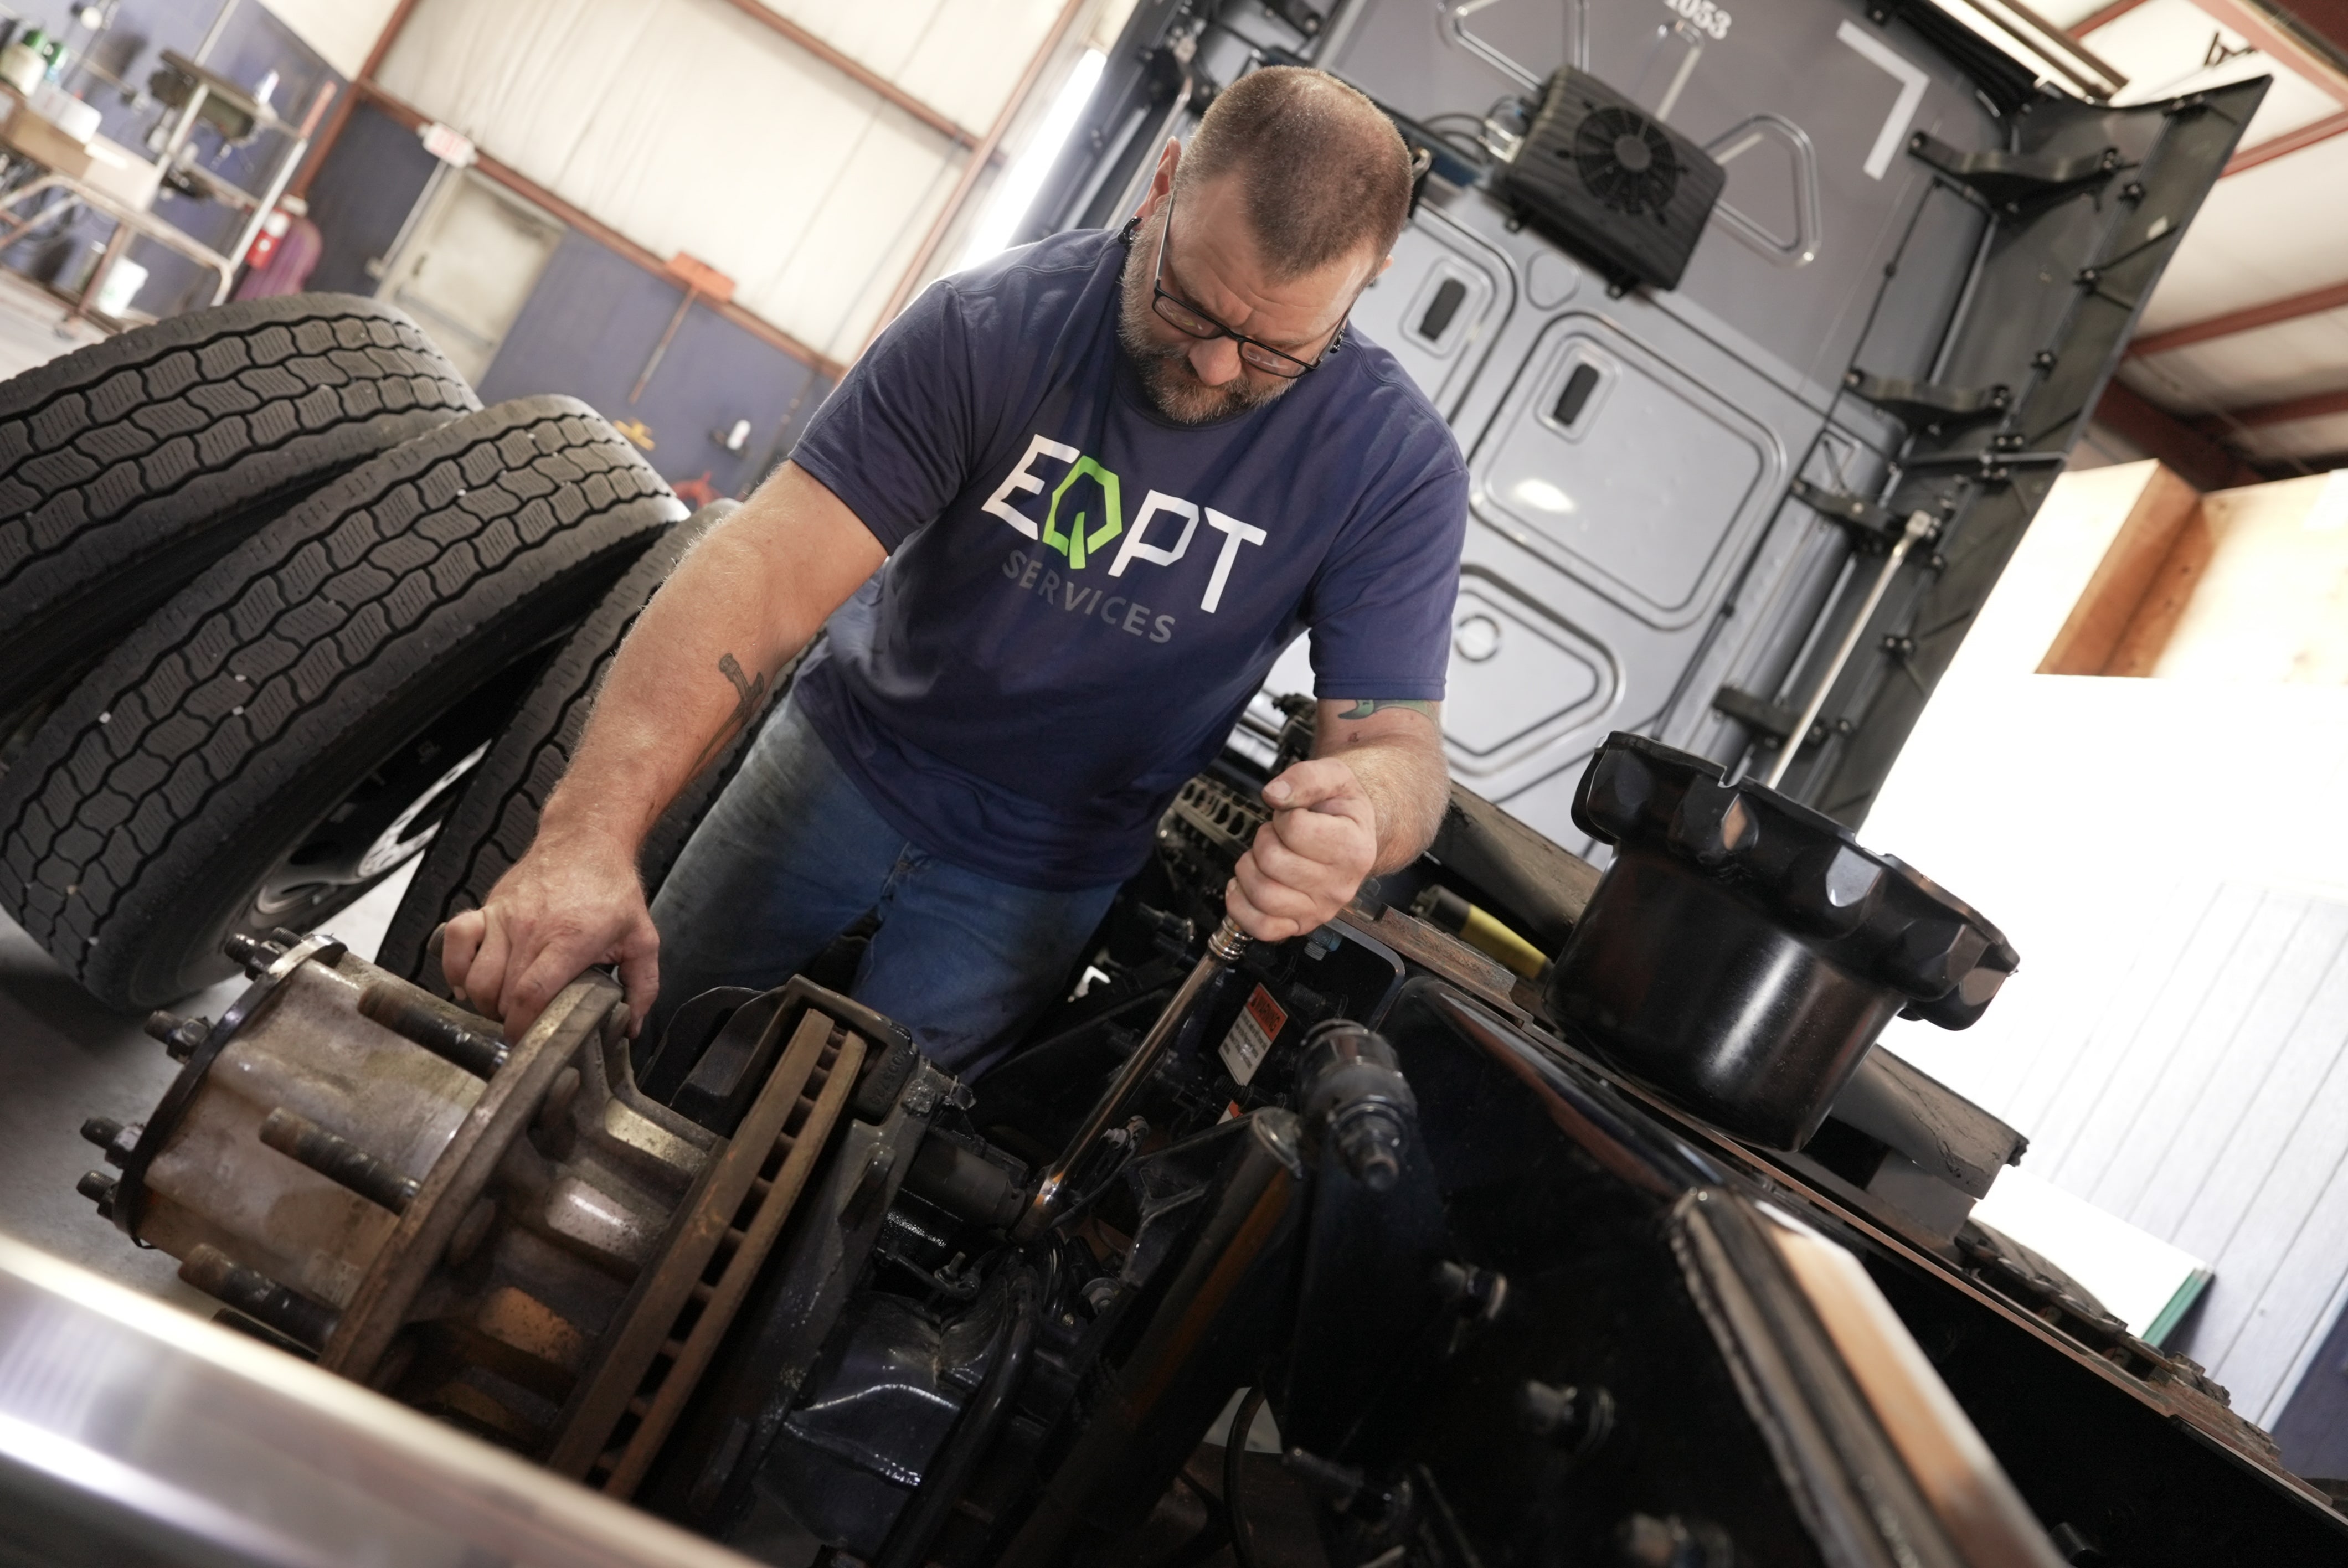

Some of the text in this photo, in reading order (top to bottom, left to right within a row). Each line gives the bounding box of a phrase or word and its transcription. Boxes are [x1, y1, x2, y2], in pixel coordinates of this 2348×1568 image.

[1662, 0, 1732, 39] 053
[981, 434, 1267, 613] EQPT
[1002, 549, 1176, 643] SERVICES
